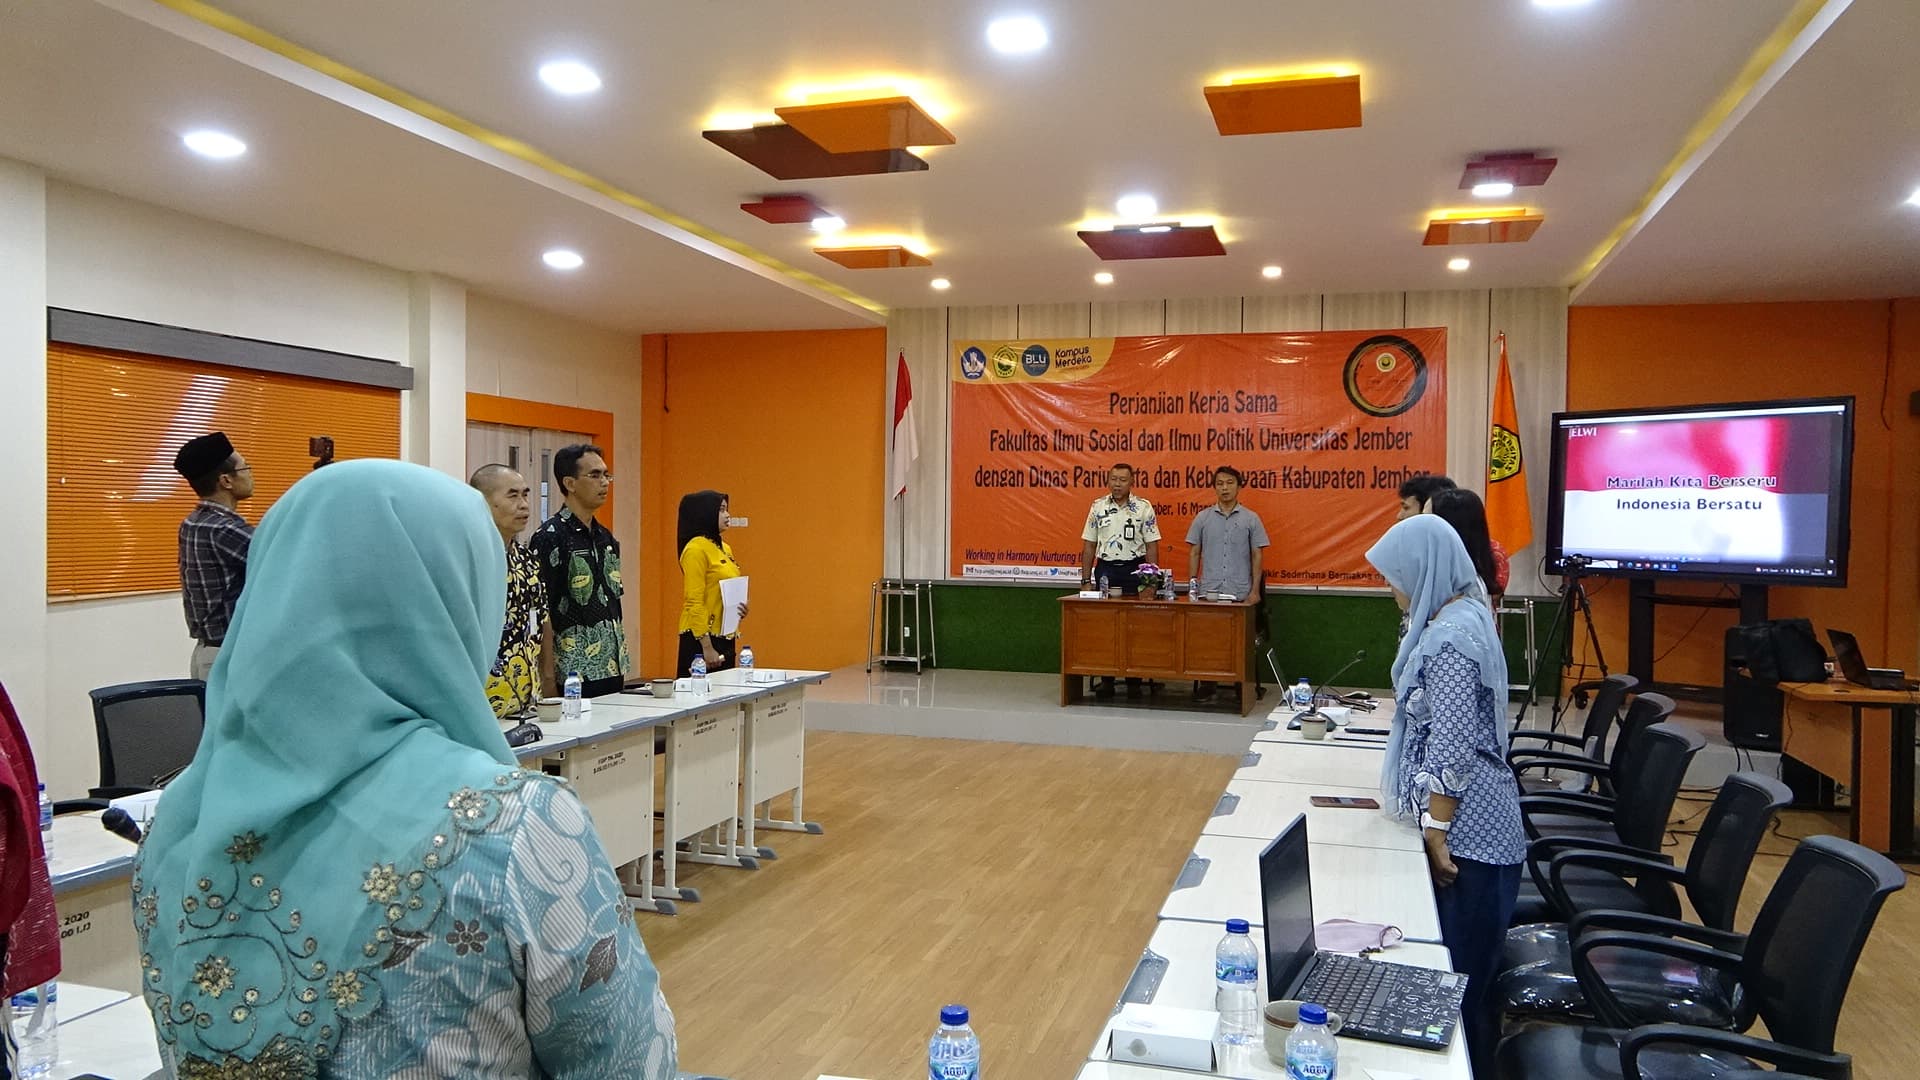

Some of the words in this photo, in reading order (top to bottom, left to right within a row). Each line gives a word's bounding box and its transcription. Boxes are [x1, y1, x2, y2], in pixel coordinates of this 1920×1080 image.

[1025, 354, 1047, 364] BLU
[1055, 346, 1089, 359] Kampus
[1055, 354, 1092, 368] Merdeka
[1109, 392, 1184, 415] Perjanjian
[1189, 391, 1229, 414] Kerja
[1235, 390, 1277, 414] Sama
[990, 429, 1048, 451] Fakultas
[1053, 429, 1084, 451] Ilmu
[1089, 428, 1133, 451] Sosial
[1137, 428, 1164, 451] dan
[1169, 428, 1201, 451] Ilmu
[1207, 428, 1254, 451] Politik
[1260, 427, 1348, 451] Universitas
[1353, 427, 1413, 450] Jember
[975, 465, 1024, 488] dengan
[1029, 465, 1068, 488] Dinas
[1074, 465, 1149, 489] Pariwta
[1154, 465, 1180, 489] dan
[1186, 465, 1276, 489] Kebyaan
[1282, 465, 1366, 489] Kabupaten
[1607, 476, 1664, 489] Marilah
[1669, 475, 1703, 488] Kita
[1708, 475, 1777, 488] Berseru
[1177, 501, 1188, 516] 16
[1616, 498, 1691, 510] Indonesia
[1697, 498, 1762, 510] Bersatu
[965, 549, 995, 563] Working
[997, 549, 1004, 560] in
[1006, 549, 1039, 564] Harmony
[1041, 550, 1076, 564] Nurturing
[1281, 569, 1326, 580] Sederhana
[64, 911, 90, 926] 2020
[943, 1066, 968, 1077] AQUA
[1303, 1064, 1328, 1075] AQUA
